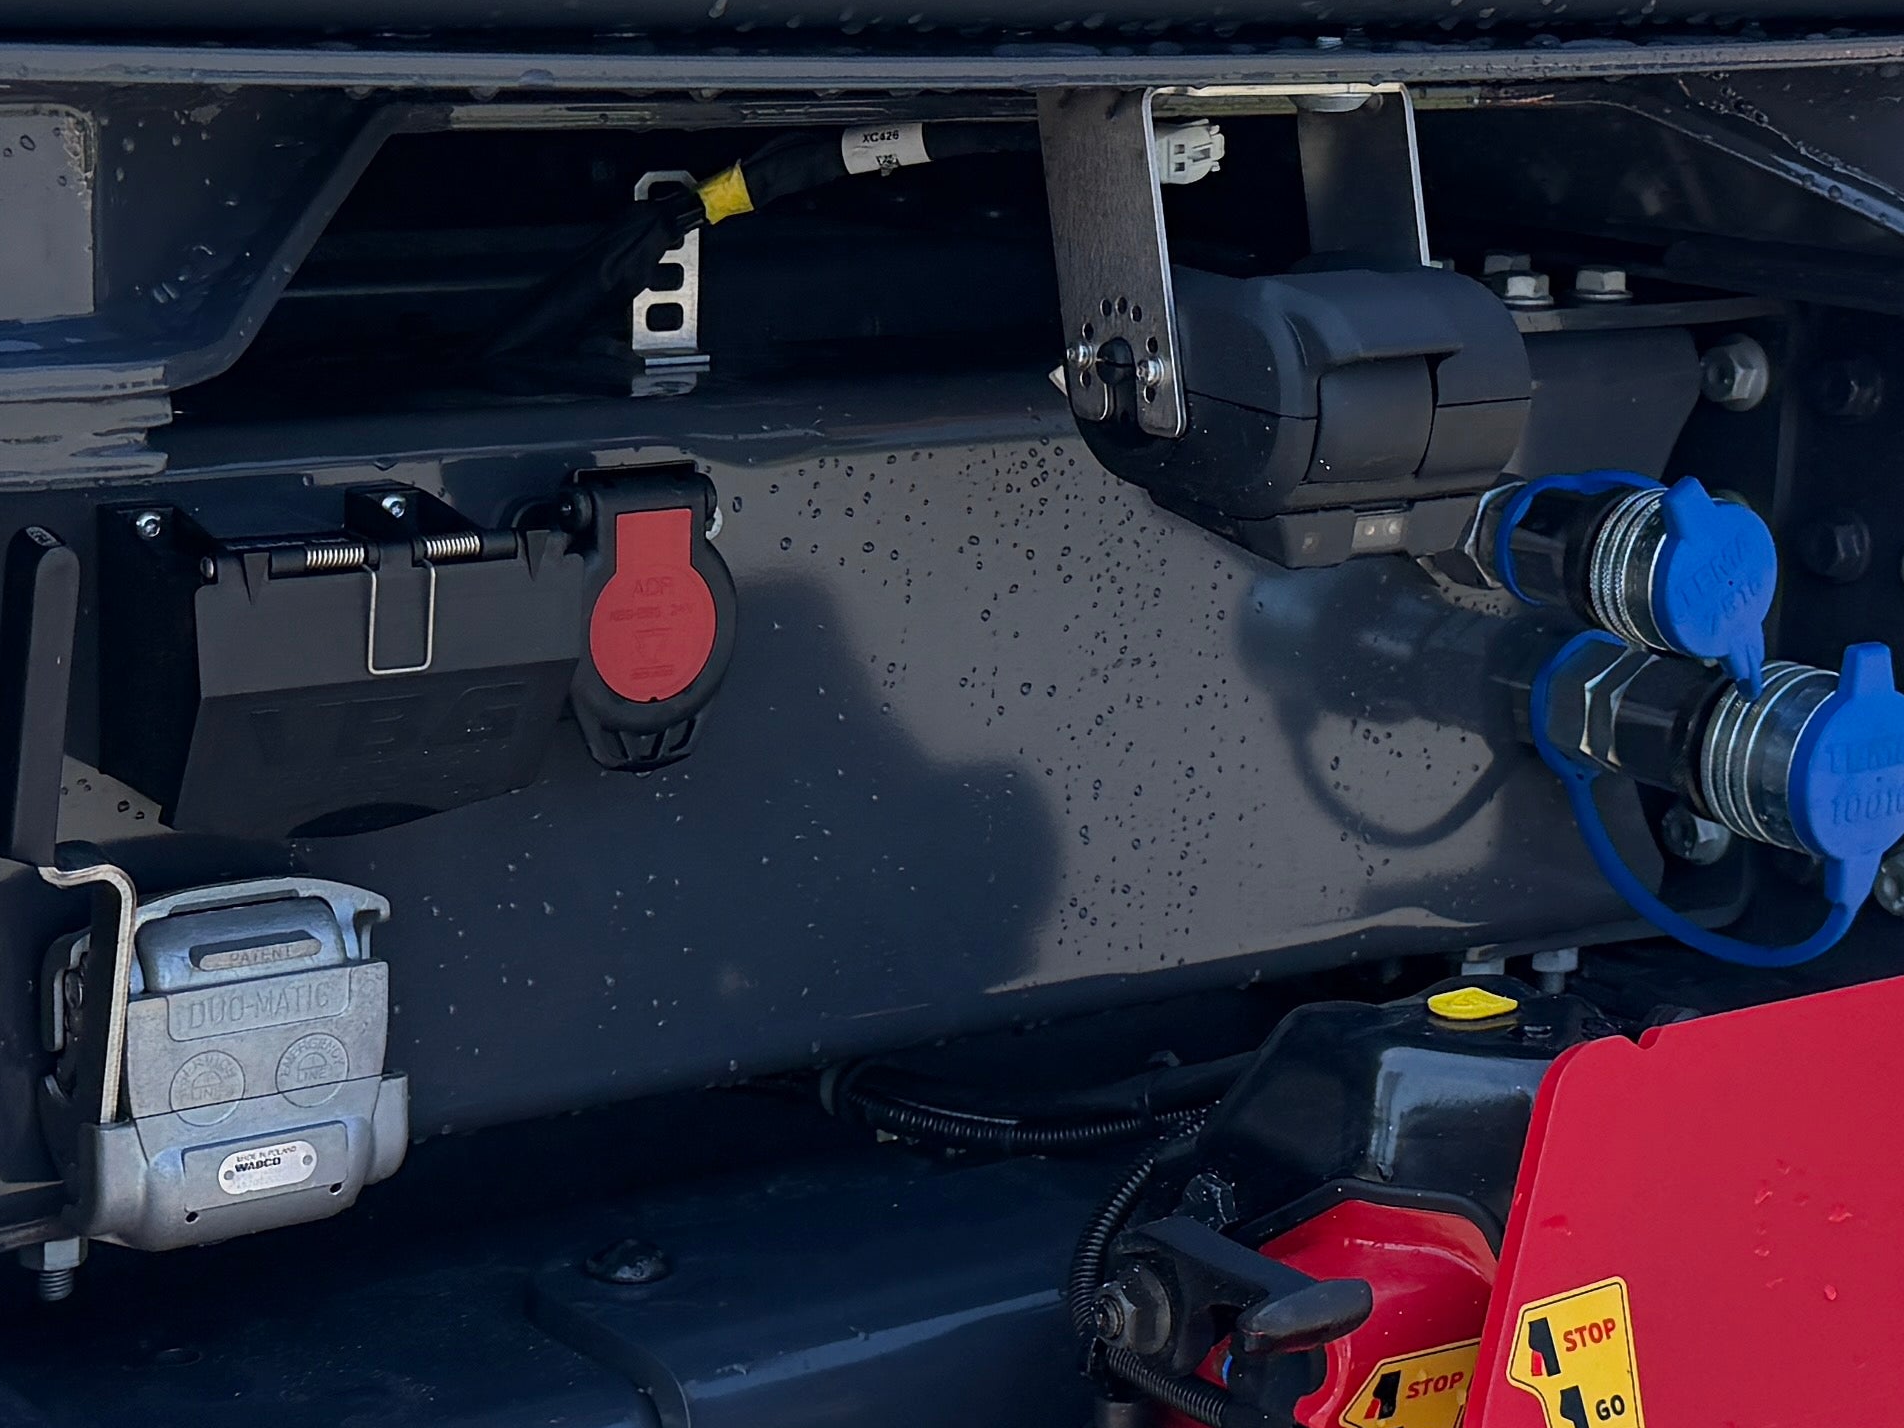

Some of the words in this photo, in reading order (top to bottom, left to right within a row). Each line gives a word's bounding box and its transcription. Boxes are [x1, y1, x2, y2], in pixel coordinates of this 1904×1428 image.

[189, 982, 329, 1029] DUO-MATIC
[1562, 1317, 1617, 1353] STOP
[1405, 1371, 1465, 1400] STOP
[1595, 1393, 1626, 1421] GO
